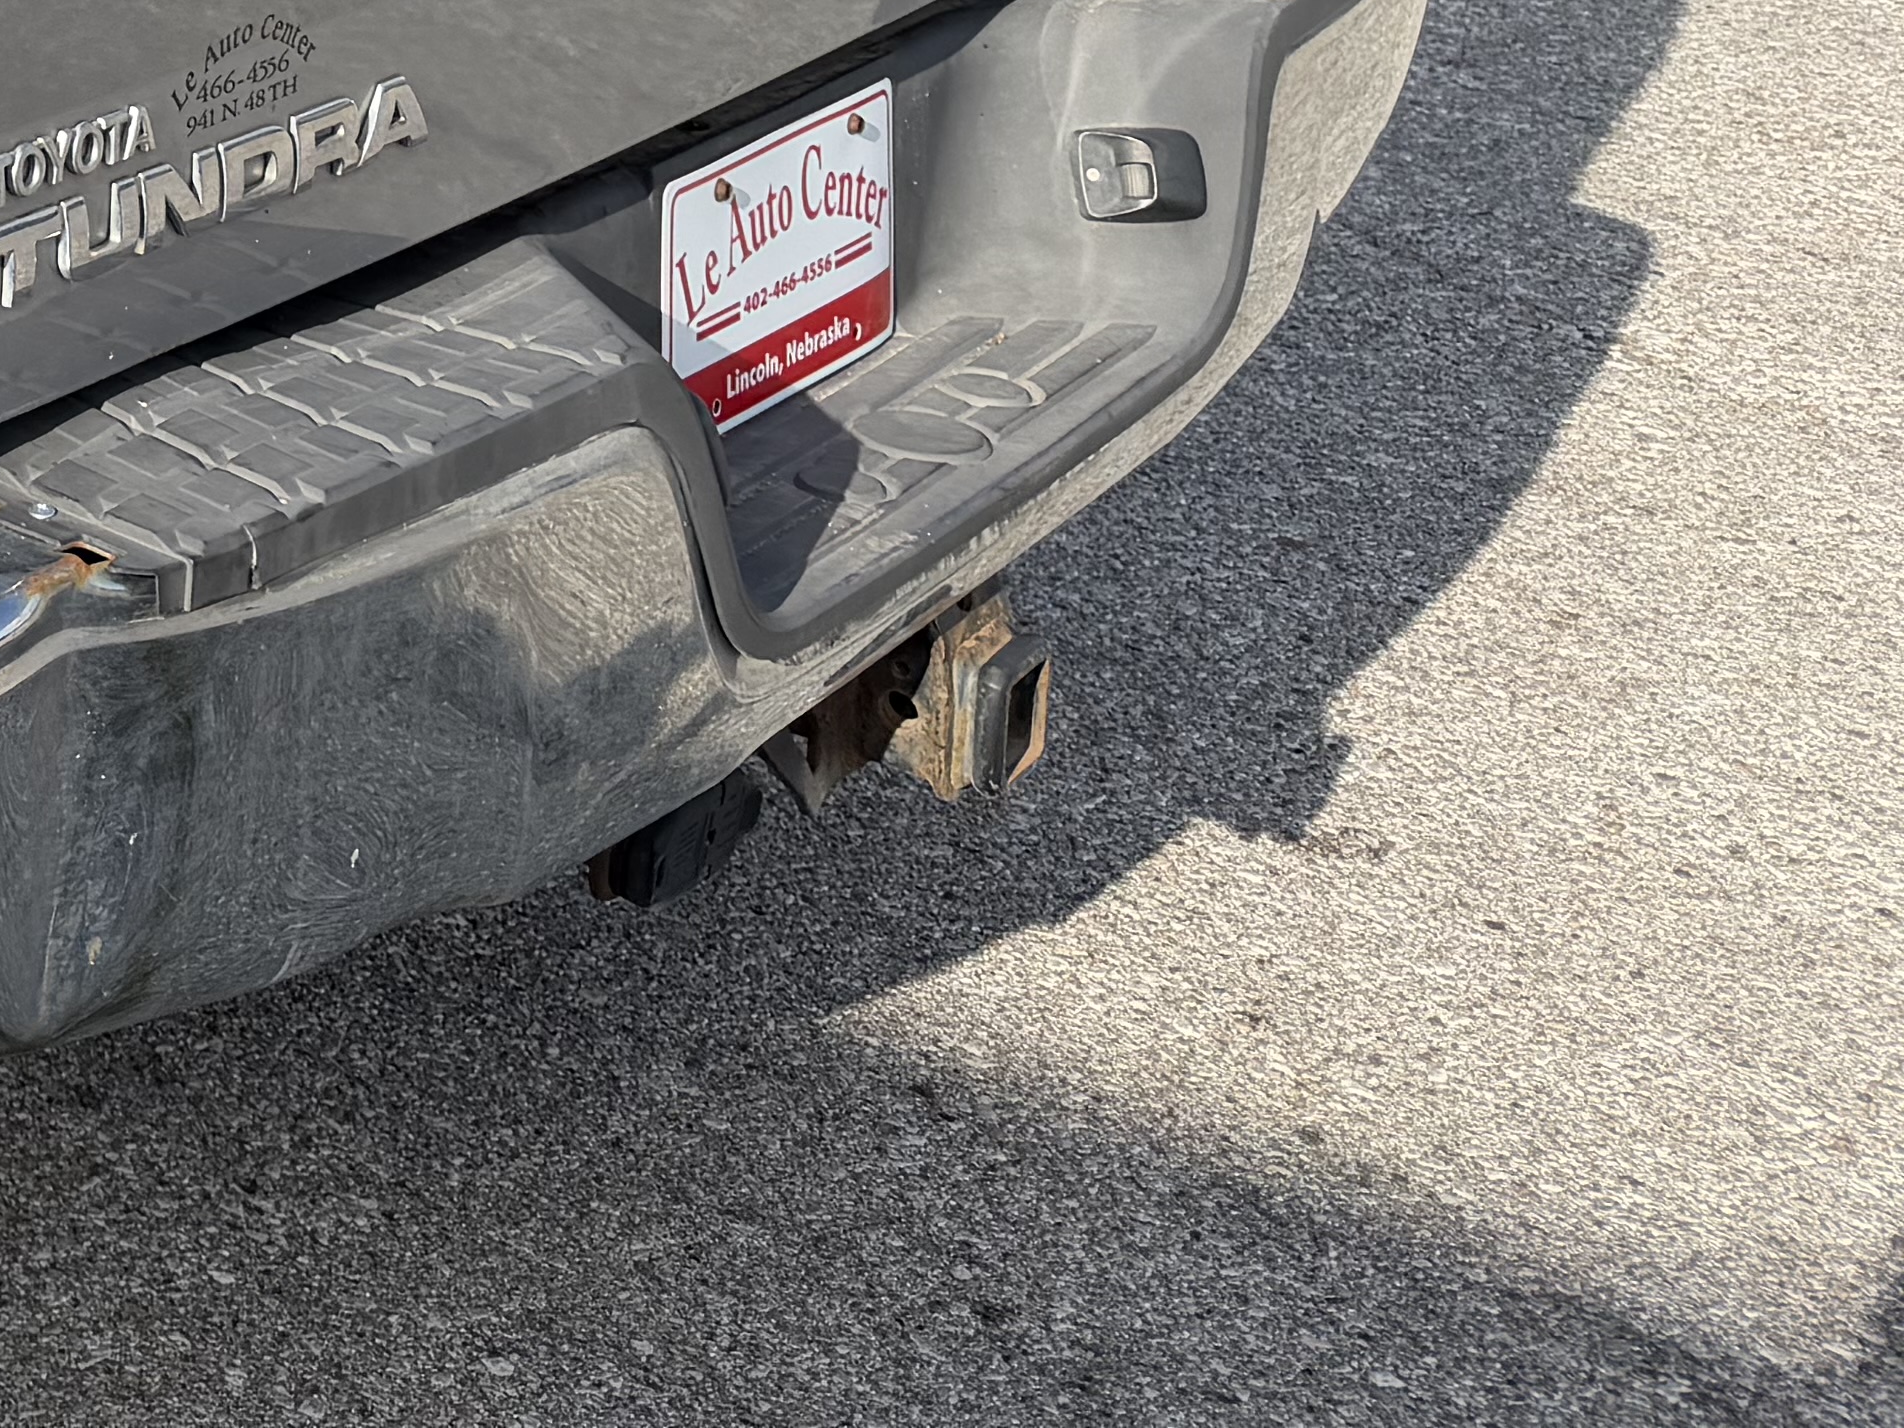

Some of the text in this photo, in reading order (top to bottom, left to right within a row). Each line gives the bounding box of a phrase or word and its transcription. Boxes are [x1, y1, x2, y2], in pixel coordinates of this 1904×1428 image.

[171, 13, 316, 112] Le Auto Center
[195, 48, 290, 103] 466-4556
[186, 107, 216, 138] 941
[221, 99, 240, 123] N.
[675, 144, 889, 327] Le Auto Center
[743, 252, 833, 314] 402-466-4556
[726, 316, 851, 400] Lincoln, Nebraska
